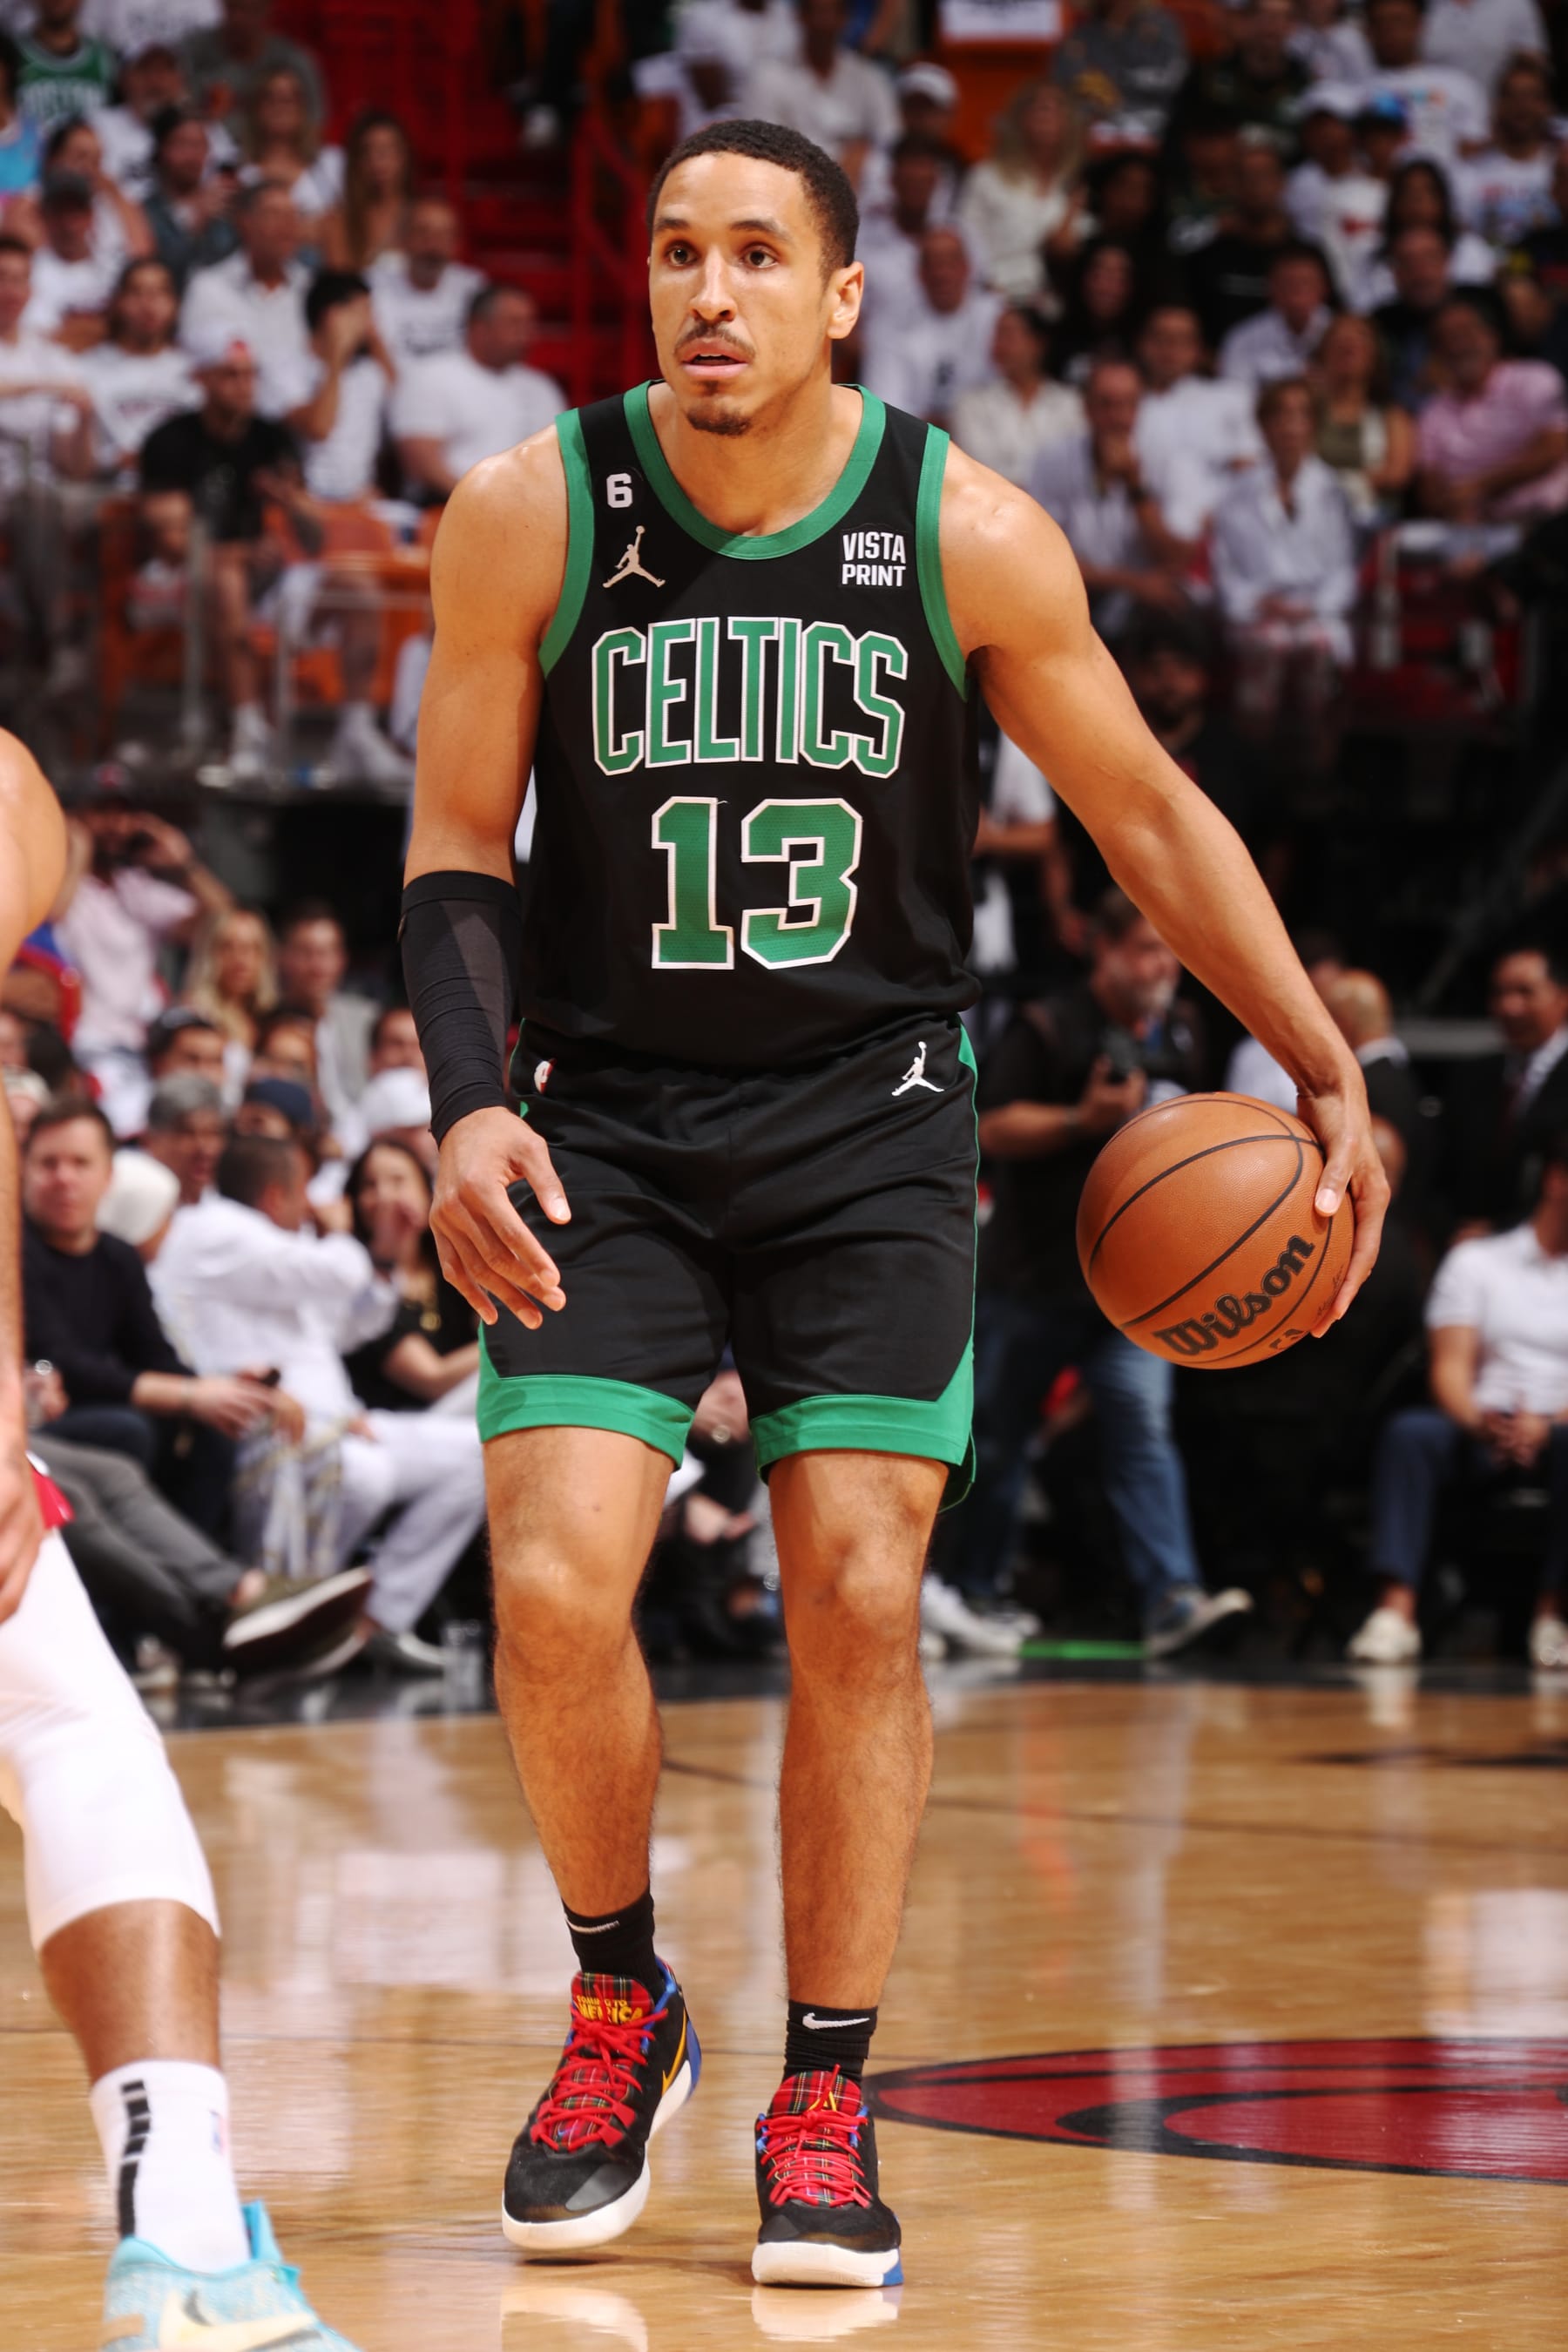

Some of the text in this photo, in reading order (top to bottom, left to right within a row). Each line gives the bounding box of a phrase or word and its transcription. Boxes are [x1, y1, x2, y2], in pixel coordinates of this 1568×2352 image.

[606, 473, 633, 509] 6
[842, 531, 907, 564] VISTA
[841, 564, 907, 587] PRINT
[591, 617, 909, 779] CELTICS
[652, 796, 863, 970] 13
[1151, 1234, 1315, 1356] Wilson
[578, 2003, 644, 2024] MERICA
